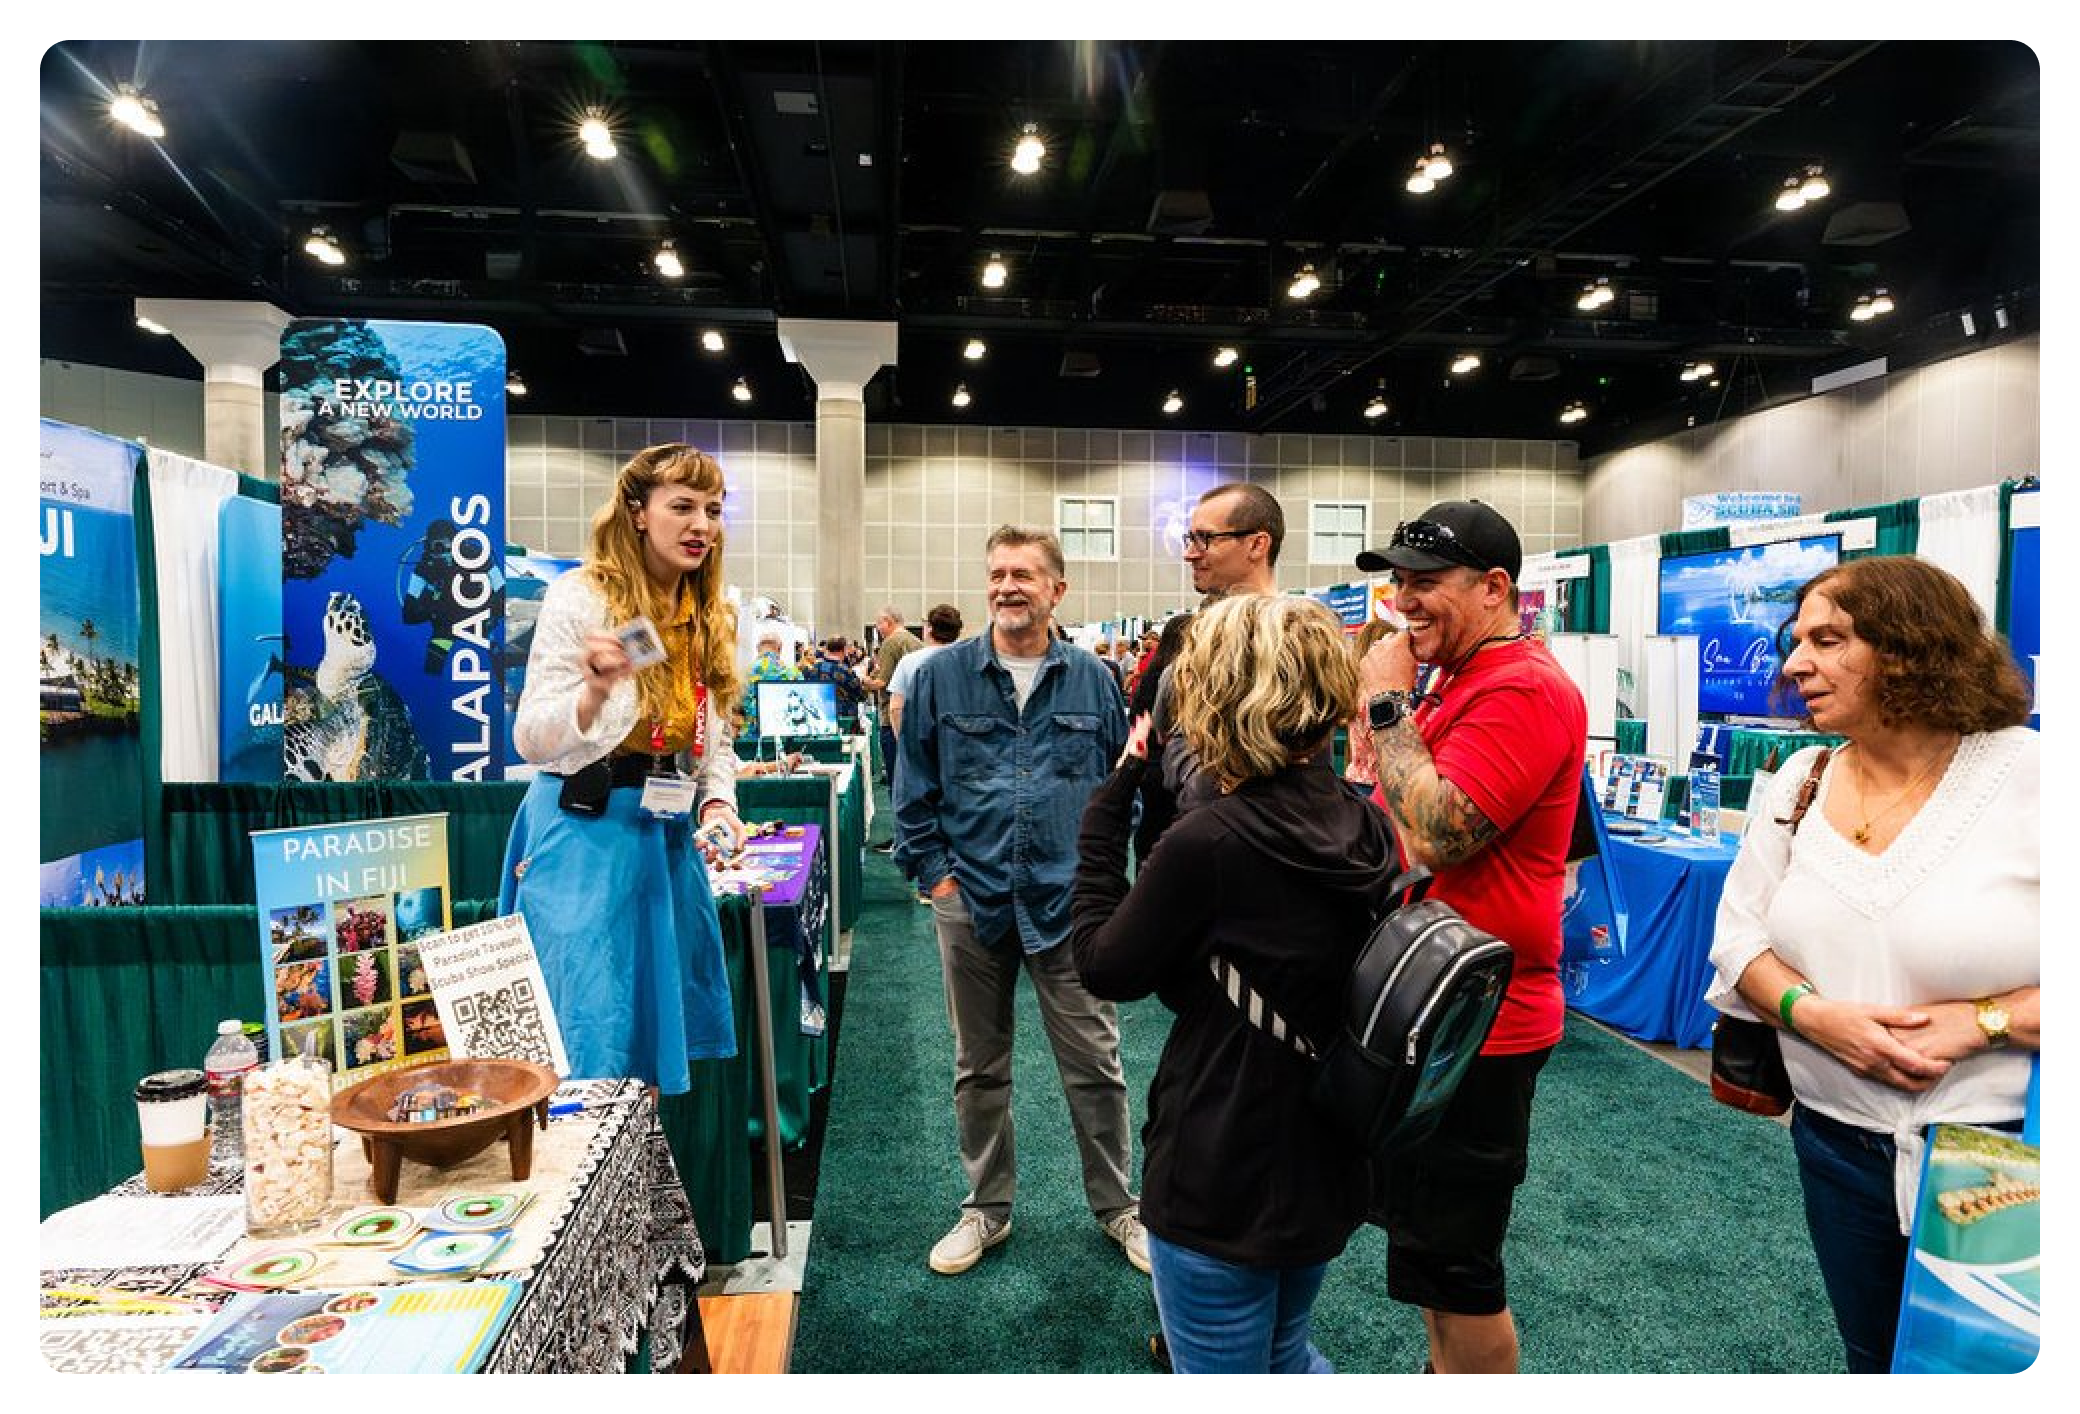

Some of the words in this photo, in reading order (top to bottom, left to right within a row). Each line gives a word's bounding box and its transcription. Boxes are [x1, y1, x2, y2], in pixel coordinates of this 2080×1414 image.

[335, 378, 474, 403] EXPLORE
[318, 401, 334, 417] A
[341, 401, 393, 417] NEW
[399, 403, 483, 419] WORLD
[71, 482, 90, 502] Spa
[40, 507, 75, 558] JI
[451, 493, 491, 782] ALAPAGOS
[249, 703, 285, 726] GAL
[283, 823, 432, 863] PARADISE
[316, 870, 350, 898] IN
[362, 863, 408, 892] FIJI
[447, 934, 460, 945] to
[430, 972, 465, 991] Scuba
[466, 963, 495, 980] Show
[496, 949, 534, 971] Special
[433, 947, 481, 968] Paradise
